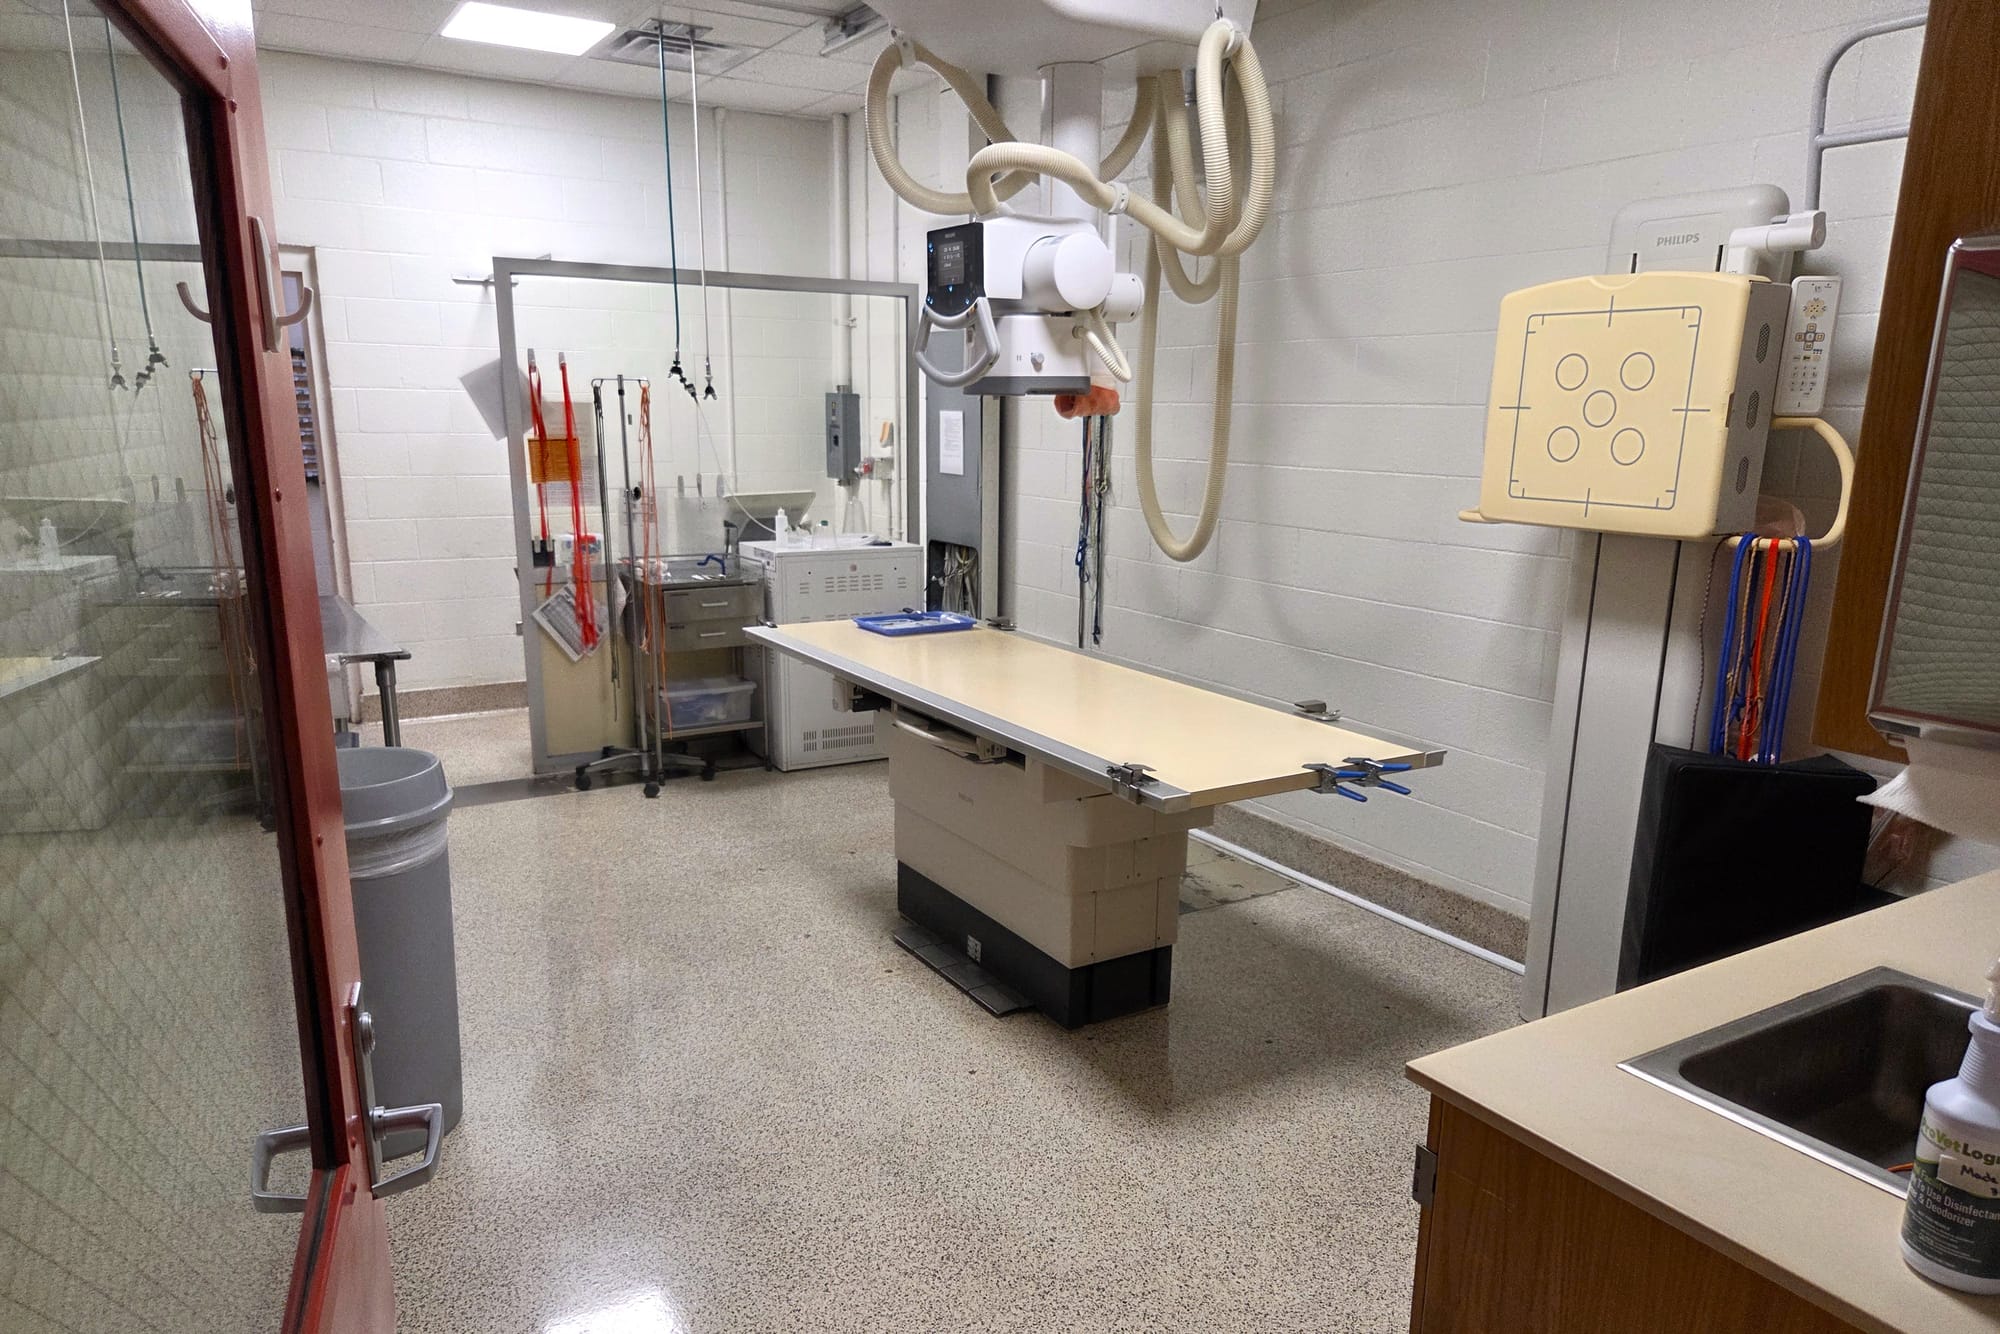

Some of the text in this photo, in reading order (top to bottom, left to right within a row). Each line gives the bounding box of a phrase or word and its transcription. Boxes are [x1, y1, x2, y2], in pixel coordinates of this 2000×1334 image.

[1656, 232, 1700, 247] PHILIPS
[1960, 1164, 1999, 1185] Made
[1926, 1186, 1942, 1203] Use
[1925, 1199, 1977, 1228] Deodorizer
